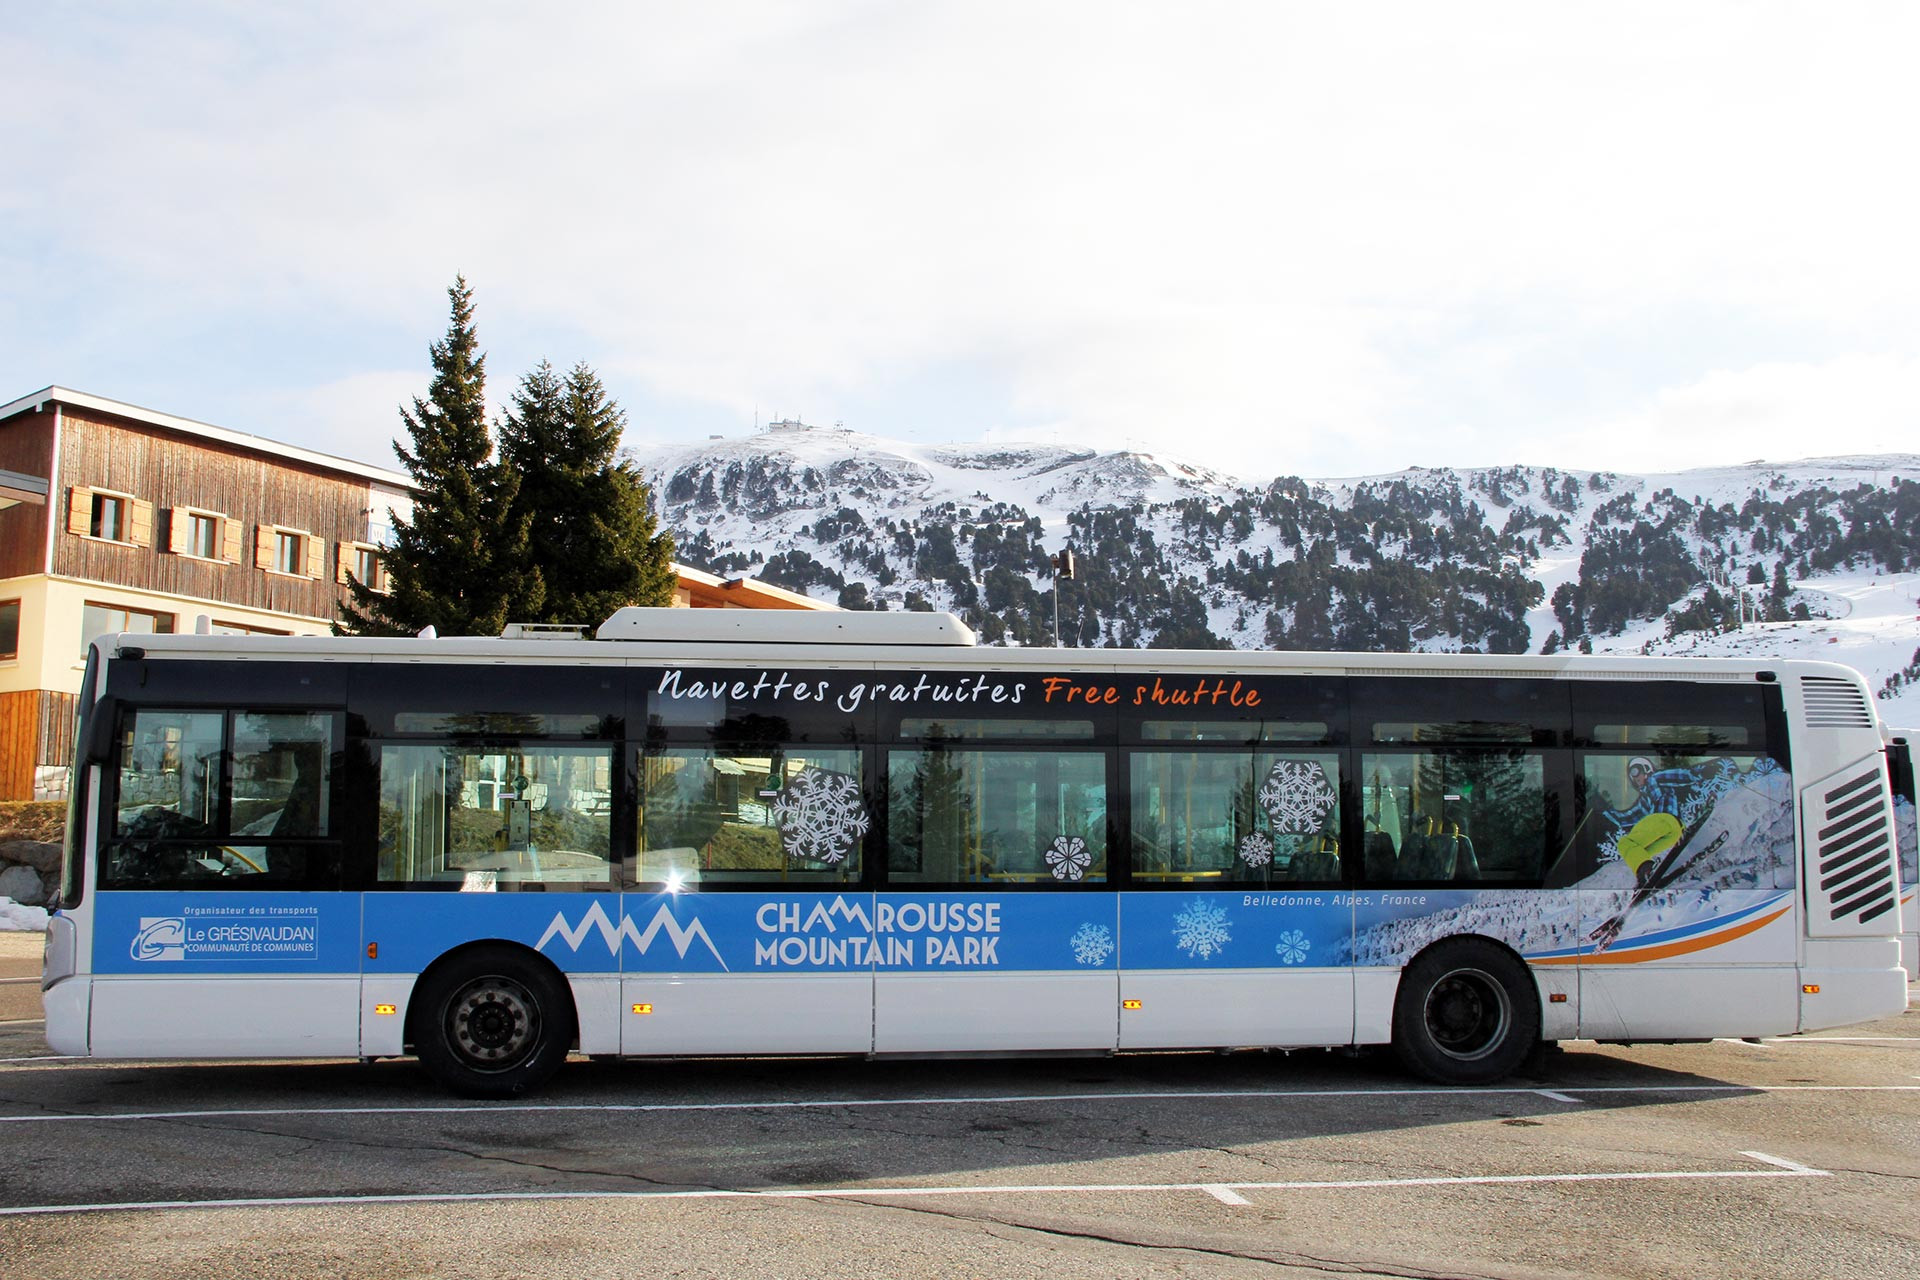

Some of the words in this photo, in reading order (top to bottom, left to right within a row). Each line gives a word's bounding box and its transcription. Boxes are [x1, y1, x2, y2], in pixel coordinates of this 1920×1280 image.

[658, 670, 829, 701] Navettes
[837, 674, 1026, 712] gratuites
[1043, 677, 1120, 705] Free
[1133, 678, 1261, 706] shuttle
[1243, 895, 1325, 907] Belledonne,
[1332, 894, 1373, 907] Alpes,
[1381, 894, 1426, 905] France
[184, 906, 245, 915] Organisateur
[269, 907, 318, 915] transports
[756, 895, 1000, 933] CHAMROUSSE
[188, 927, 205, 941] Le
[208, 923, 314, 941] GRÉSIVAUDAN
[188, 942, 249, 952] COMMUNAUTÉ
[251, 943, 262, 952] DE
[263, 943, 314, 952] COMMUNES
[755, 936, 913, 967] MOUNTAIN
[926, 936, 999, 965] PARK
